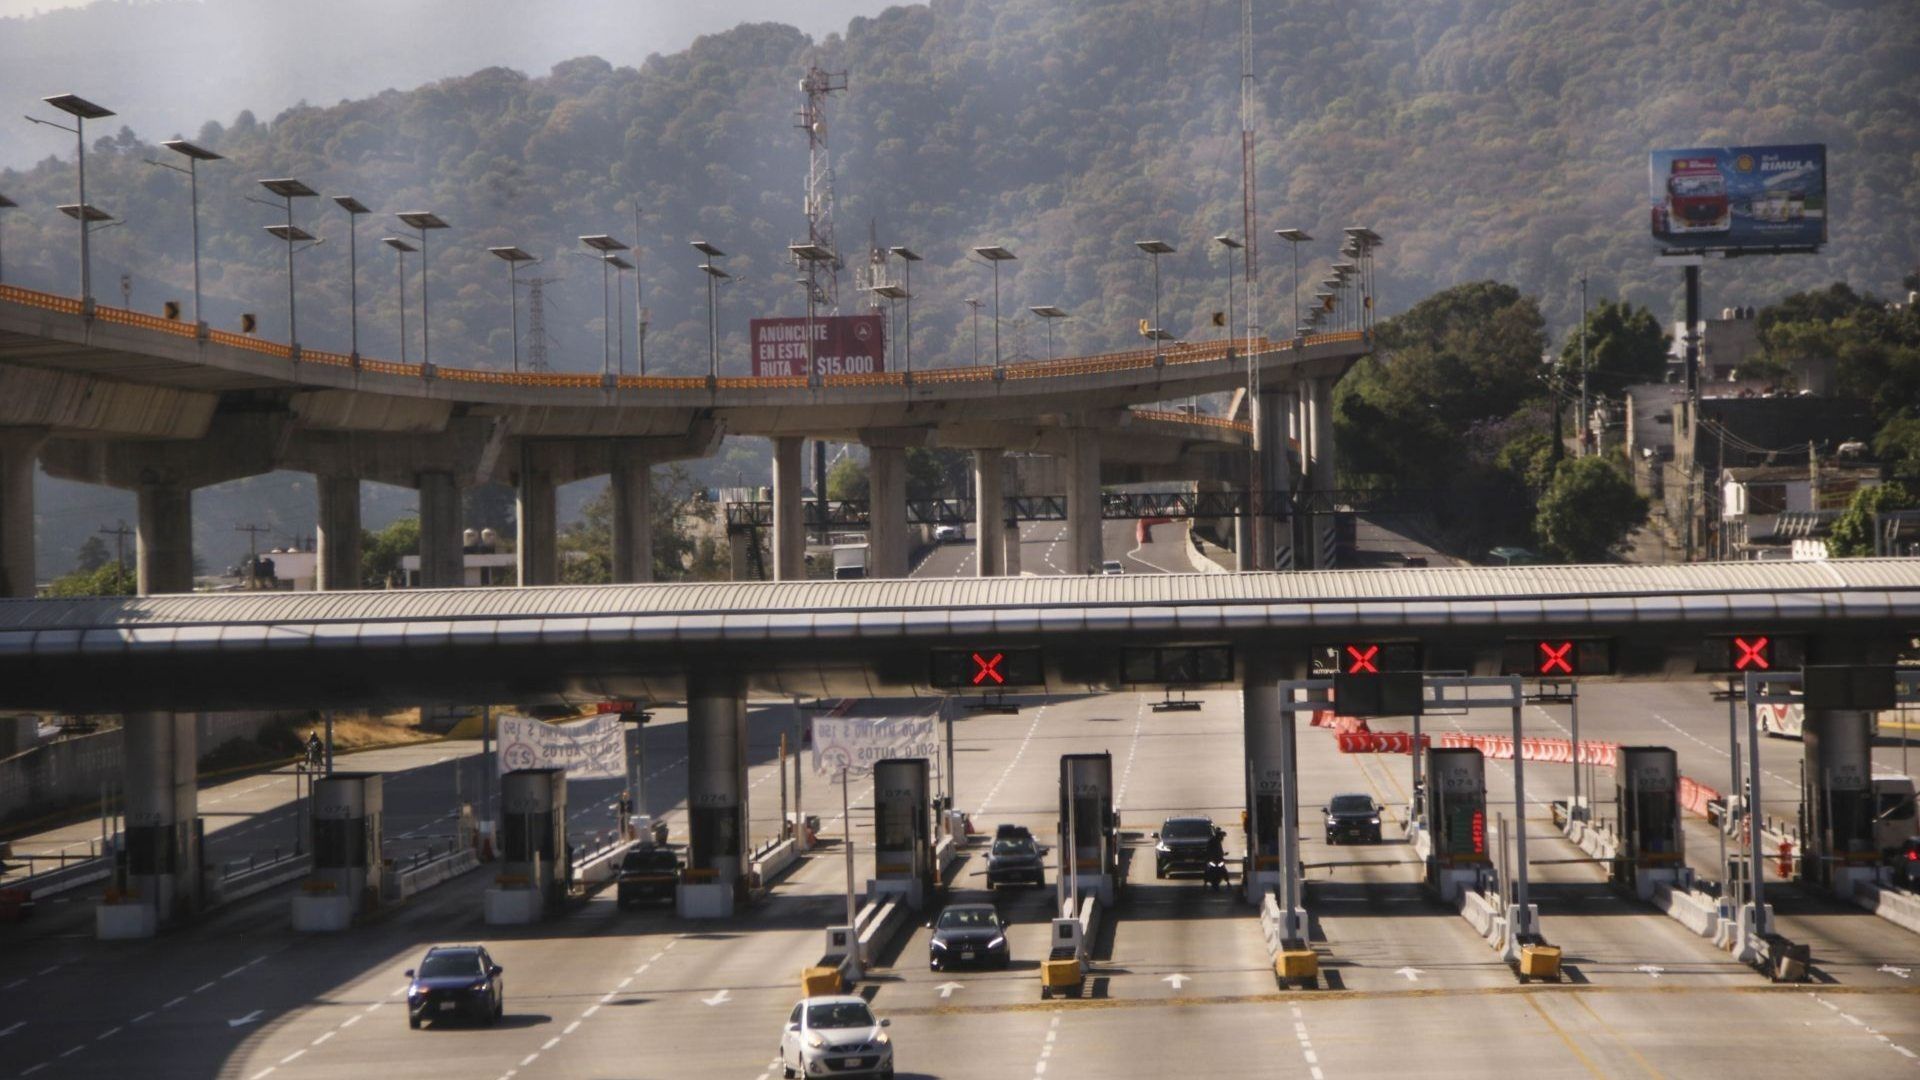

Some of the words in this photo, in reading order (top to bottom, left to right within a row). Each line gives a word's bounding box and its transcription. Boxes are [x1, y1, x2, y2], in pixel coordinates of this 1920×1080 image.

[1760, 160, 1816, 171] RIMULA
[759, 323, 828, 342] ANÚNCITE
[760, 344, 775, 360] EN
[777, 342, 808, 360] ESTA
[760, 360, 792, 377] RUTA
[817, 355, 873, 376] $15,000
